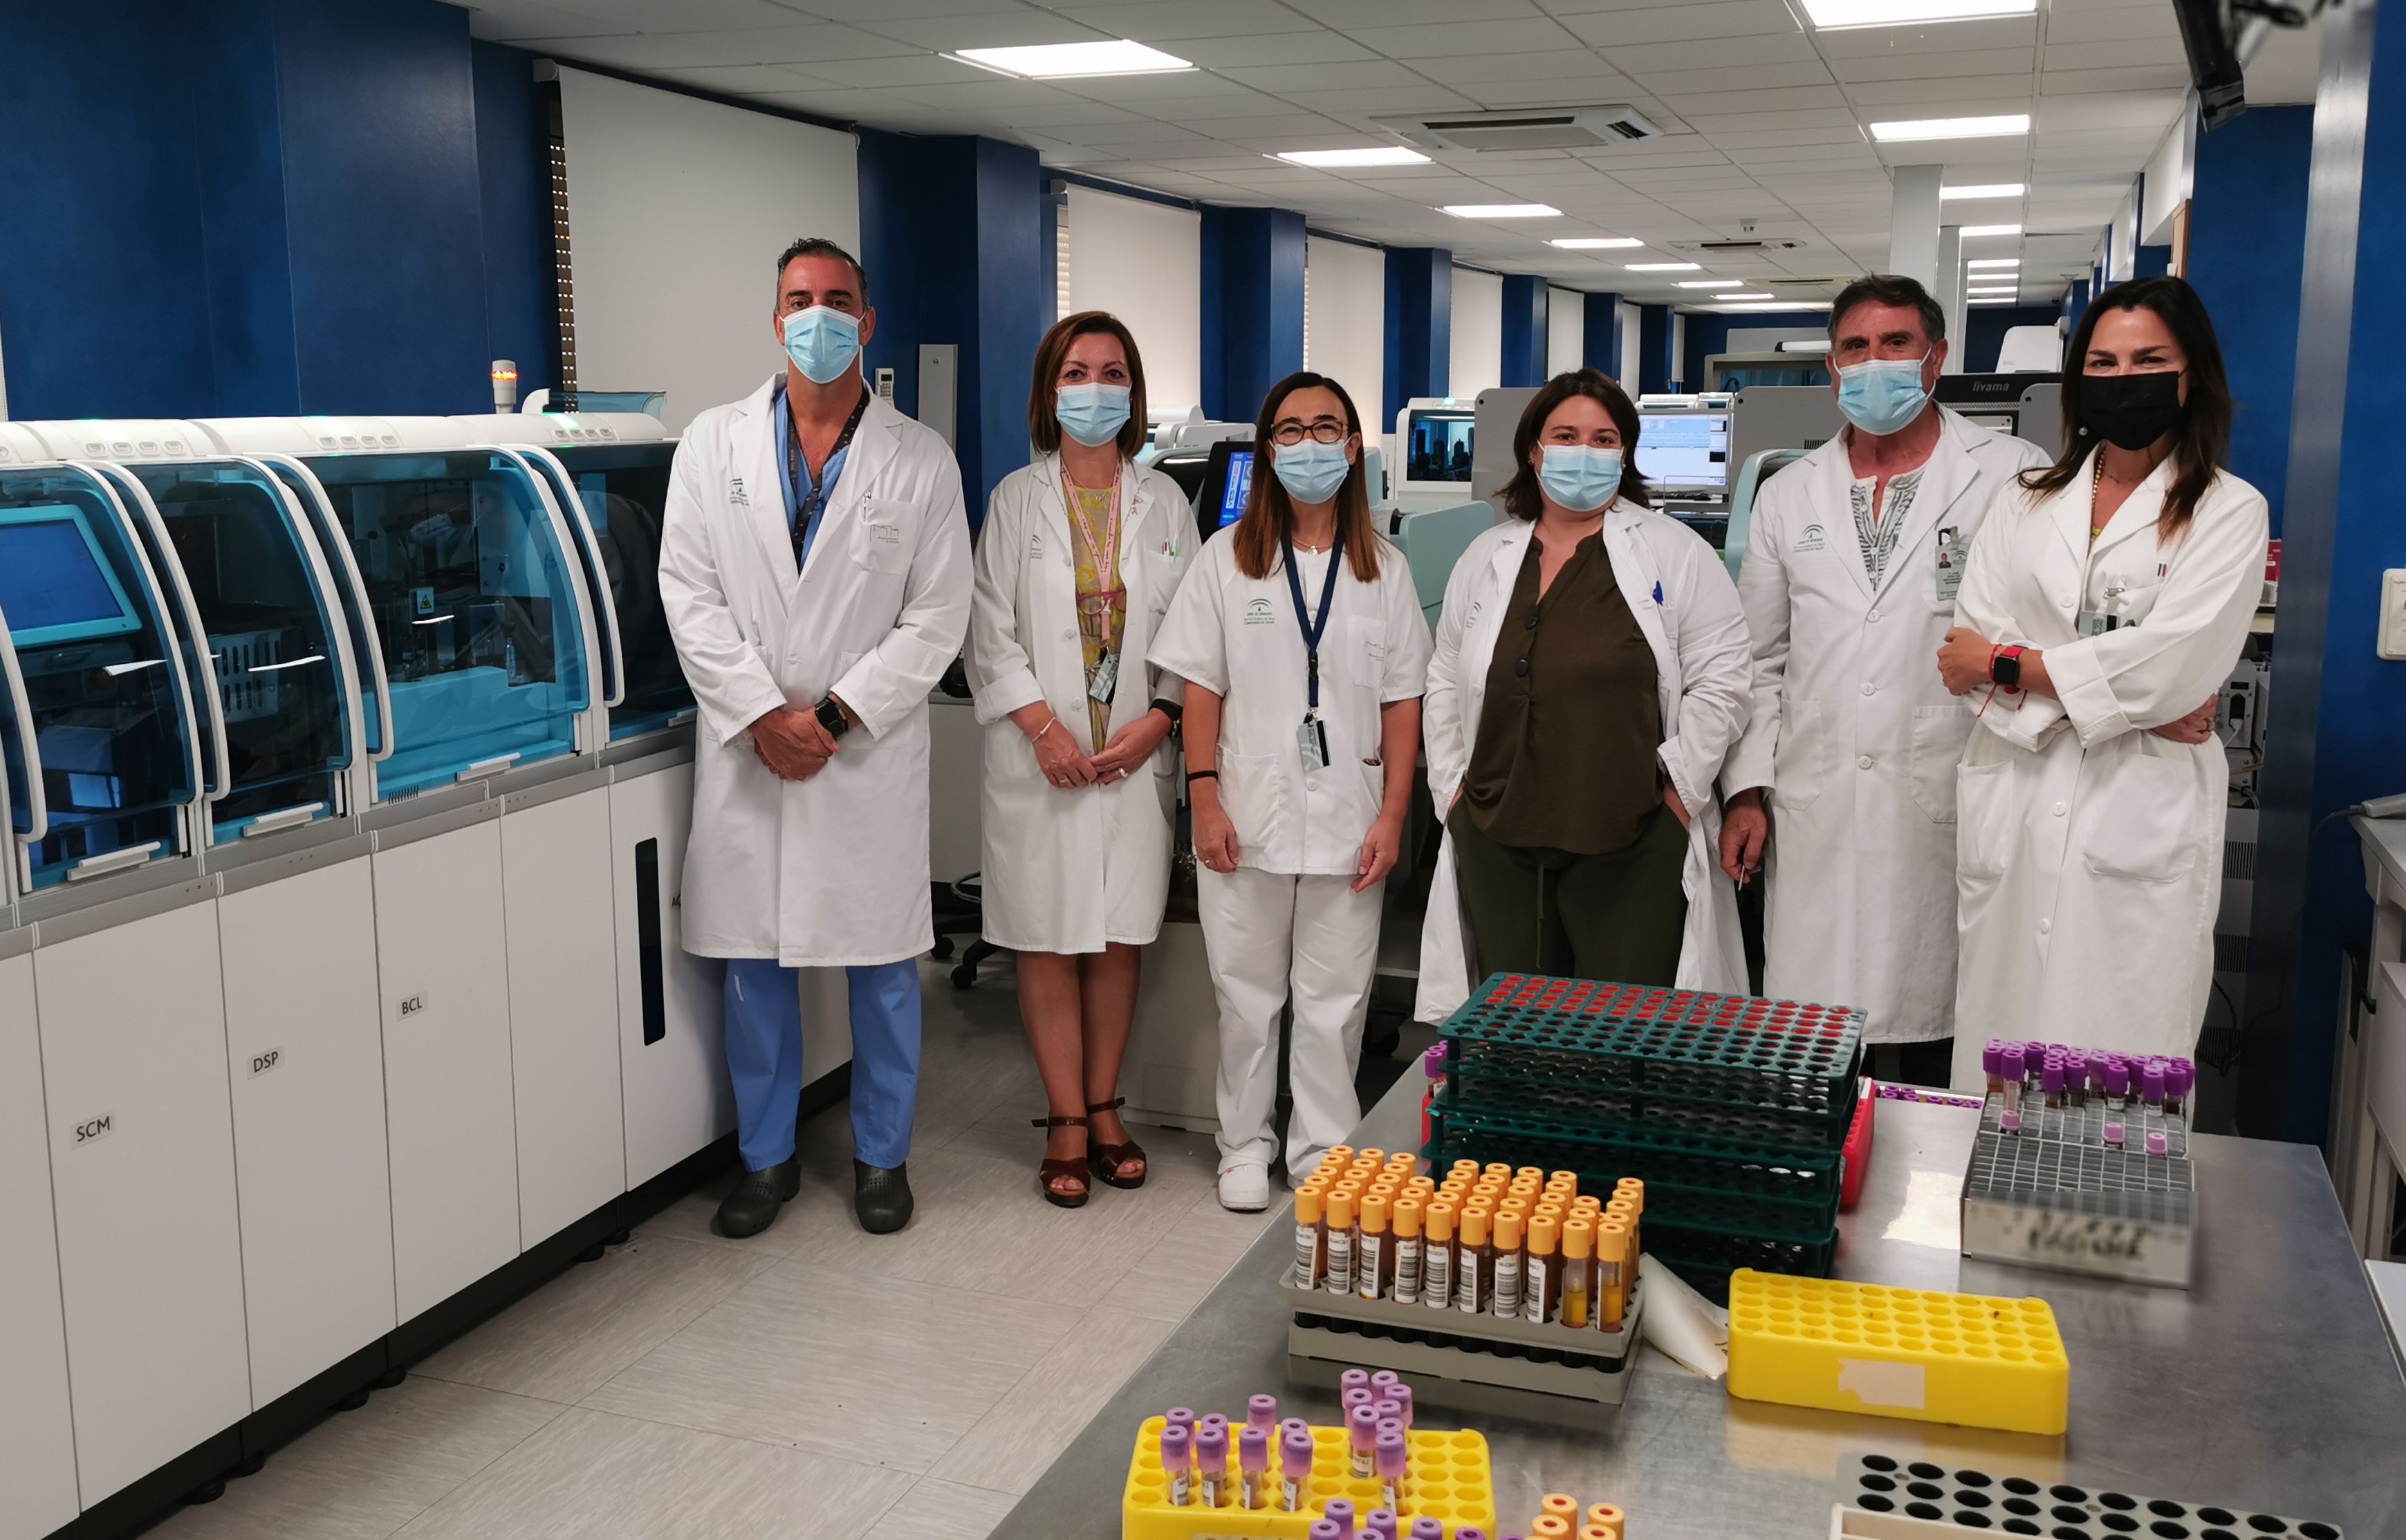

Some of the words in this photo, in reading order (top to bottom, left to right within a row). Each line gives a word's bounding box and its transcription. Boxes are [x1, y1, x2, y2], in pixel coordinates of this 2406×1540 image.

[402, 996, 423, 1015] BCL
[254, 1051, 278, 1073] DSP
[76, 1115, 110, 1142] SCM
